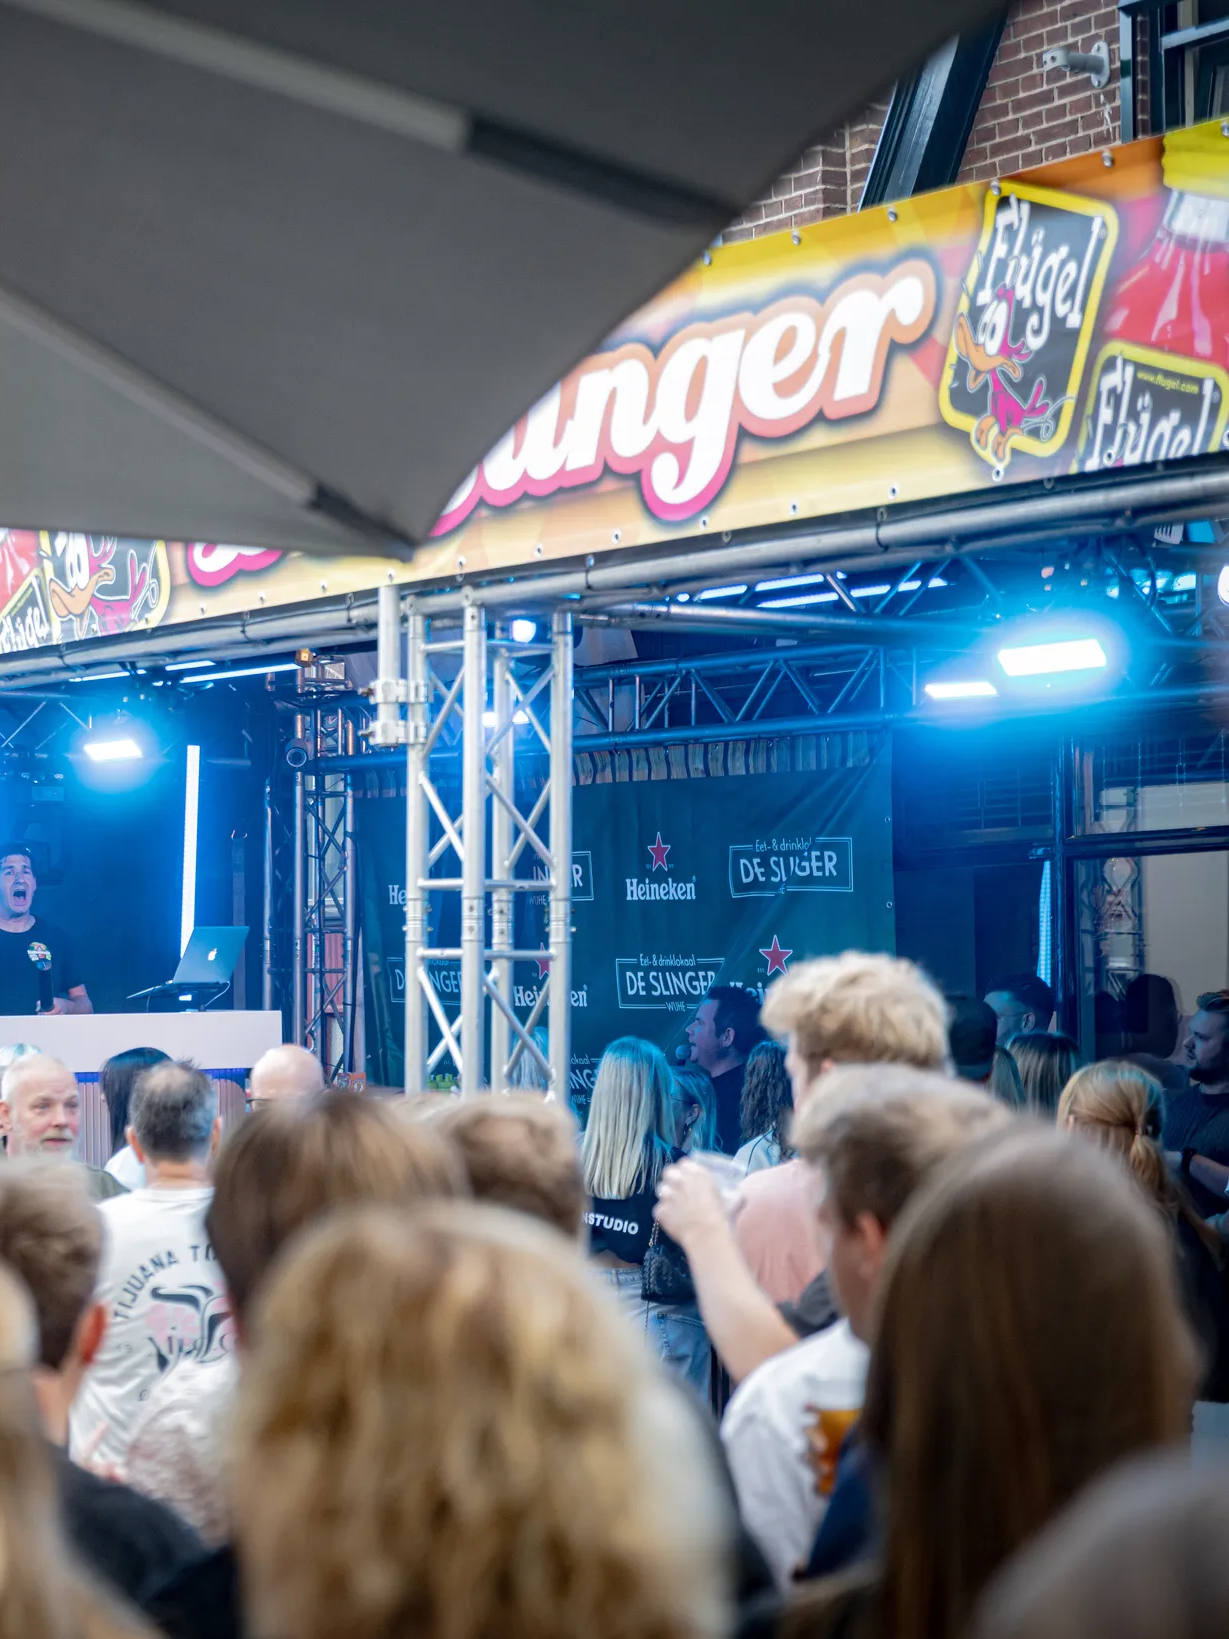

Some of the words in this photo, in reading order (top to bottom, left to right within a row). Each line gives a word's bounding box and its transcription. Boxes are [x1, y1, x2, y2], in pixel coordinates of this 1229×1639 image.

[976, 192, 1105, 351] Flügel
[439, 268, 931, 510] inger
[1137, 370, 1200, 395] www.flugel.com
[772, 838, 779, 851] &
[739, 858, 766, 883] DE
[625, 877, 697, 901] Heineken
[626, 971, 647, 996] DE
[112, 1249, 180, 1321] TIJUANA
